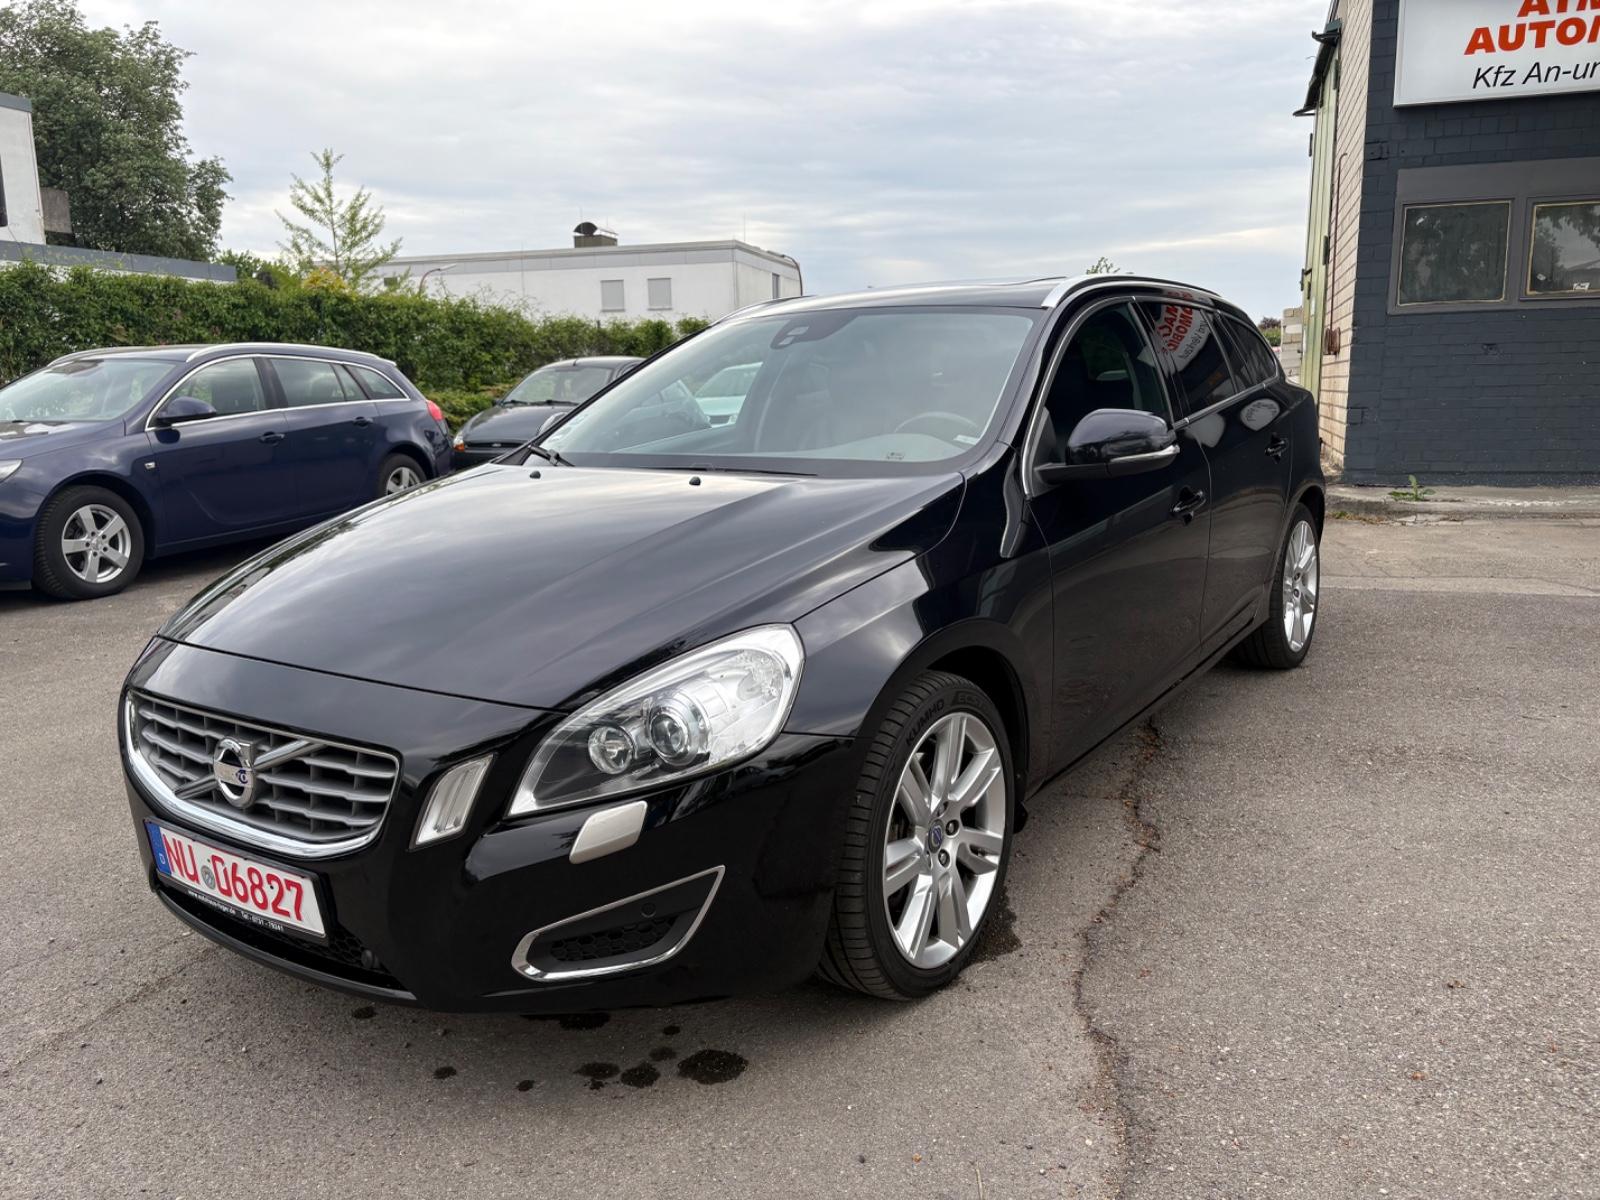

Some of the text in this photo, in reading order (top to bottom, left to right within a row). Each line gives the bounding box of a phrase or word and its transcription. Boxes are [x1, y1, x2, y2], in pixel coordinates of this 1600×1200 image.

[1472, 65, 1517, 89] Kfz
[905, 698, 945, 746] KUMHO
[162, 833, 200, 885] NU
